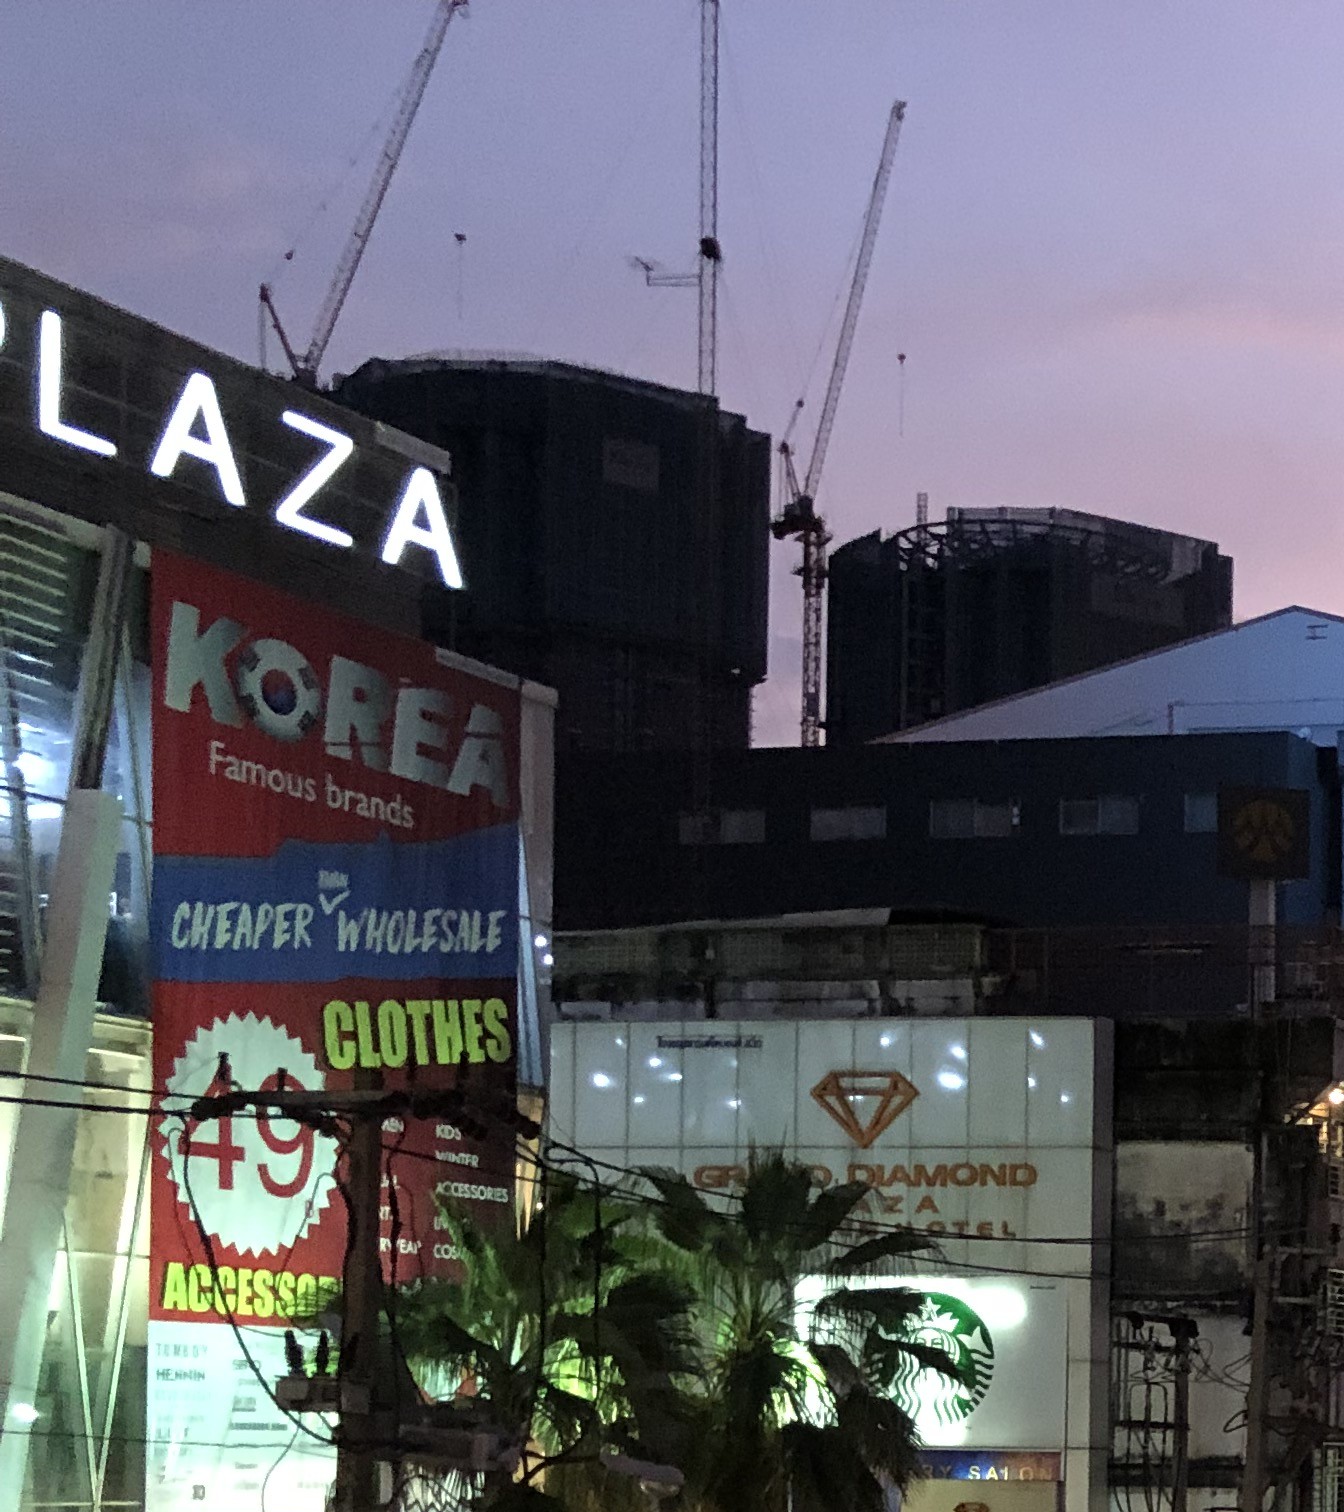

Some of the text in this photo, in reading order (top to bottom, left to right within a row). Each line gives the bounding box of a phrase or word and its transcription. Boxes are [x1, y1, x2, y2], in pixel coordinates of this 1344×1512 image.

[0, 306, 465, 590] LAZA
[163, 600, 511, 806] KOREA
[209, 739, 415, 829] Famous brands
[172, 900, 509, 954] CHEAPER WHOLESALE
[322, 997, 512, 1070] CLOTHES
[180, 1060, 314, 1198] 49
[435, 1181, 509, 1203] ACCESSORIES
[693, 1163, 1037, 1189] GRD DIAMOND
